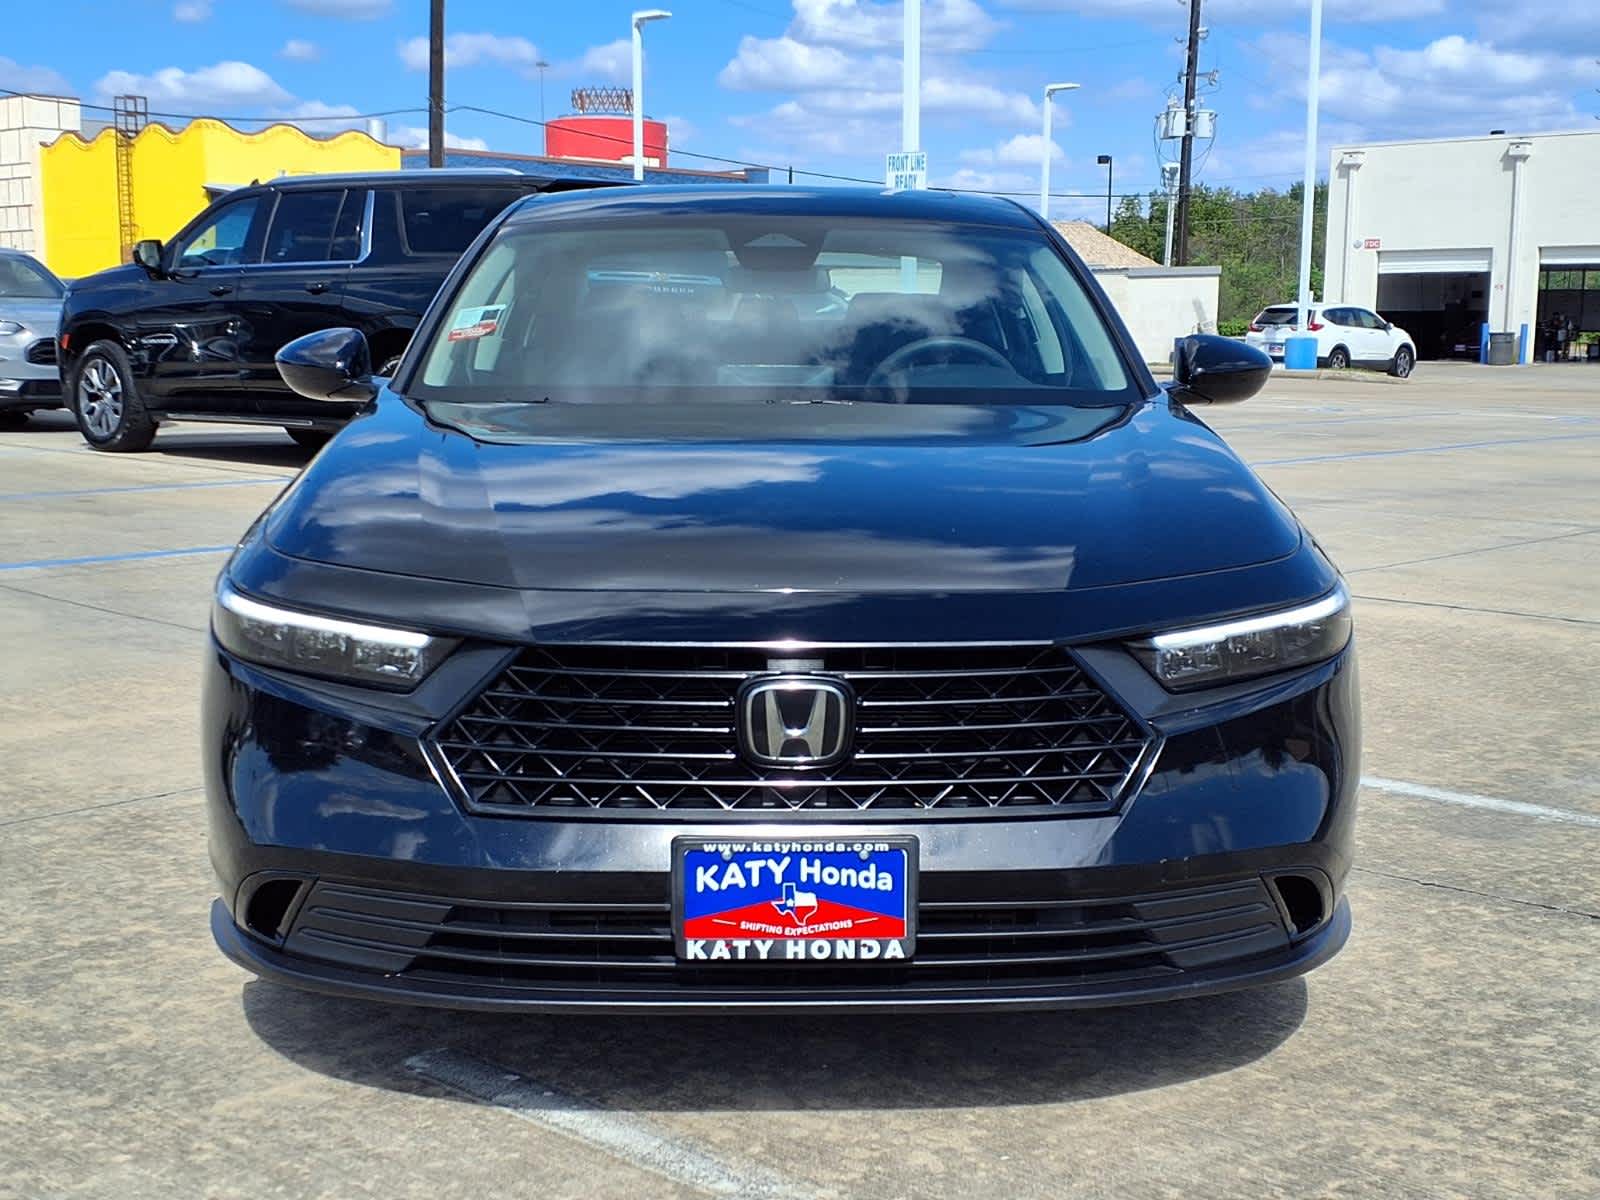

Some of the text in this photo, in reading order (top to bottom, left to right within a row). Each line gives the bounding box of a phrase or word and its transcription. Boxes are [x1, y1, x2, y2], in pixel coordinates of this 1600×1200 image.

[888, 155, 909, 171] FRONT
[703, 842, 889, 853] www.katyhonda.com
[696, 856, 893, 893] KATY Honda
[740, 919, 853, 936] SHIFTING EXPECTATIONS
[686, 939, 905, 960] KATY HONDA
